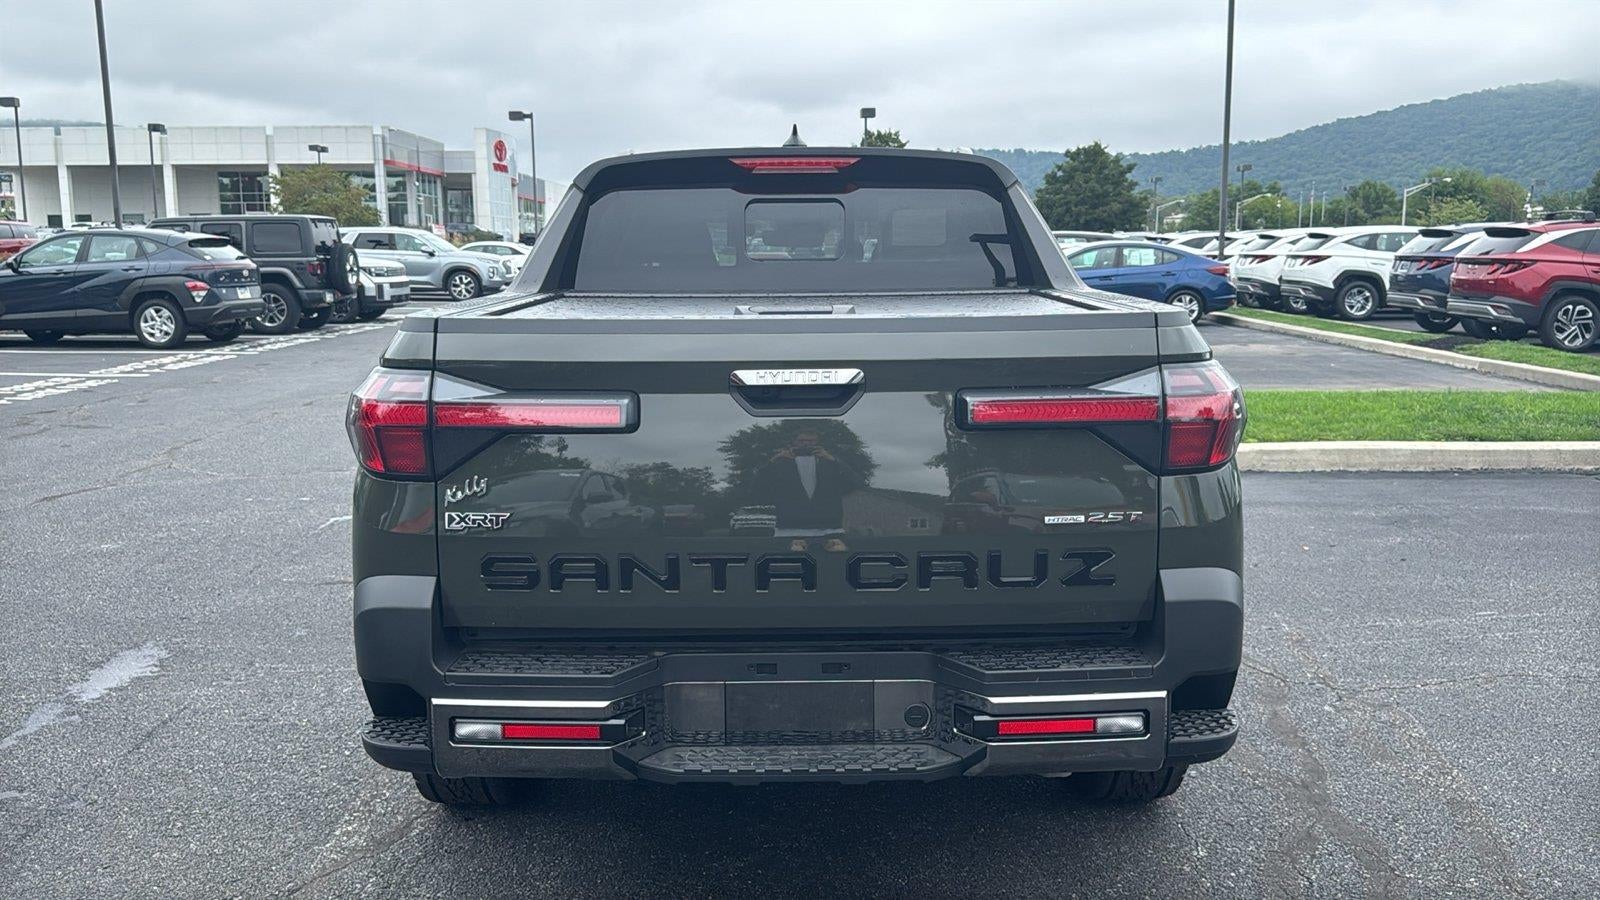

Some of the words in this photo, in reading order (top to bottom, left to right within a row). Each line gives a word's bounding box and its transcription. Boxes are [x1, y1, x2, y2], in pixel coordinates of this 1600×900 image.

[755, 370, 839, 383] HYUNDAI
[444, 475, 488, 508] Kelly
[445, 512, 511, 529] XRT
[1045, 514, 1085, 524] HTRAC
[480, 552, 817, 593] SANTA
[846, 548, 1116, 592] CRUZ
